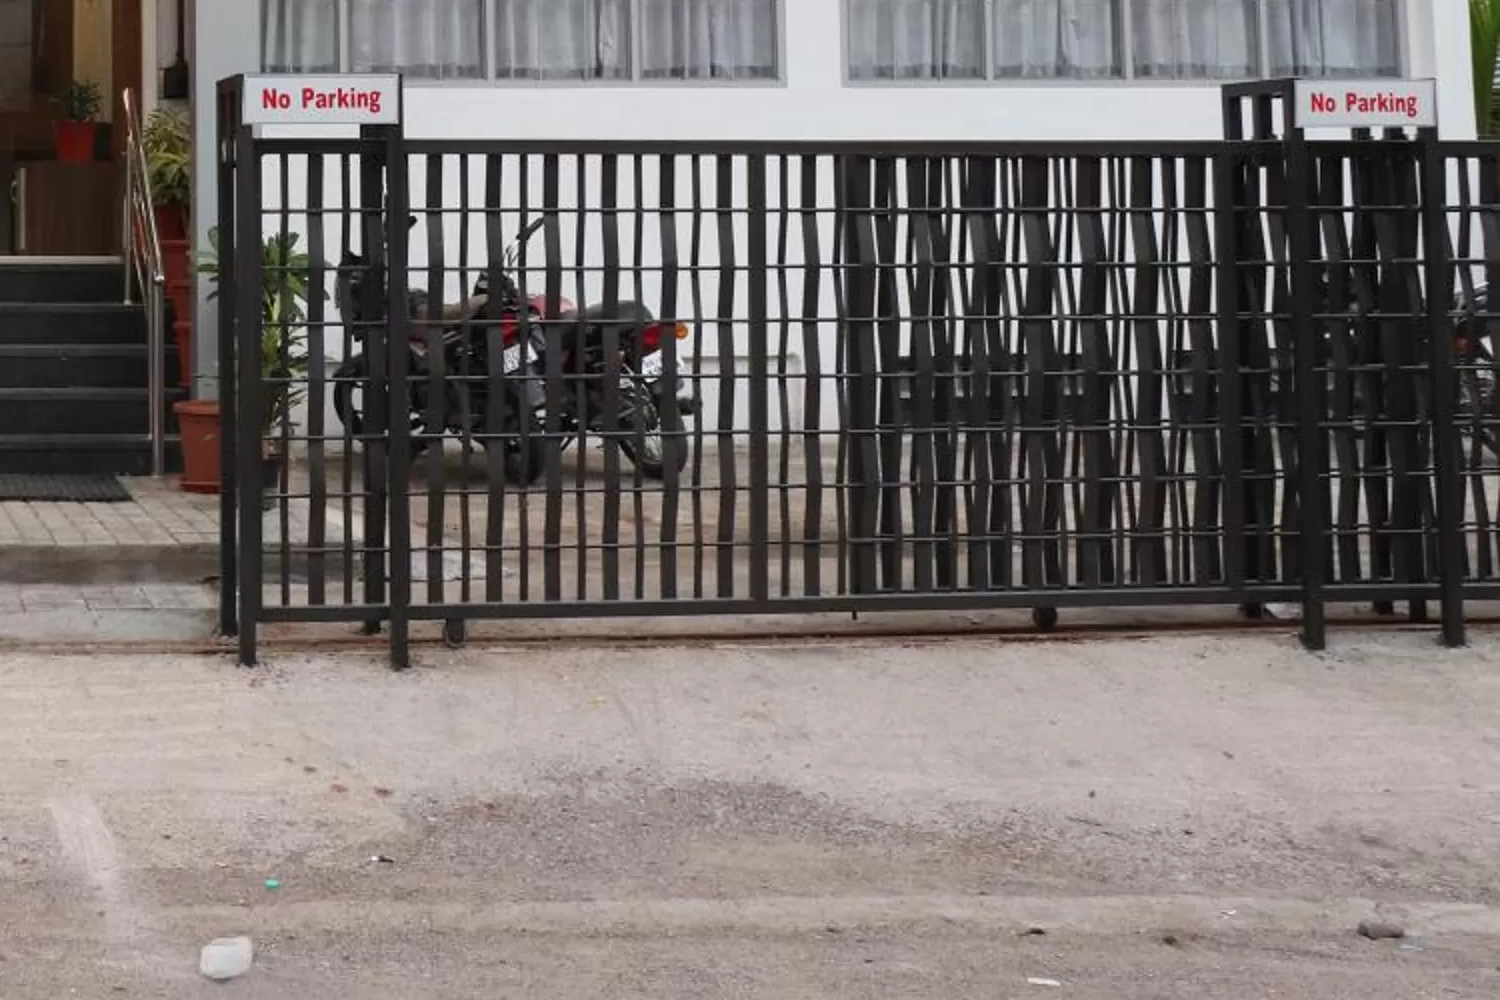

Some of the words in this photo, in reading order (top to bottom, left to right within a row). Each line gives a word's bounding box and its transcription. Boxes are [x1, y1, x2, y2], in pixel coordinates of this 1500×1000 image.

[262, 88, 291, 109] No
[302, 87, 381, 113] Parking
[1311, 93, 1336, 112] No
[1345, 93, 1418, 117] Parking
